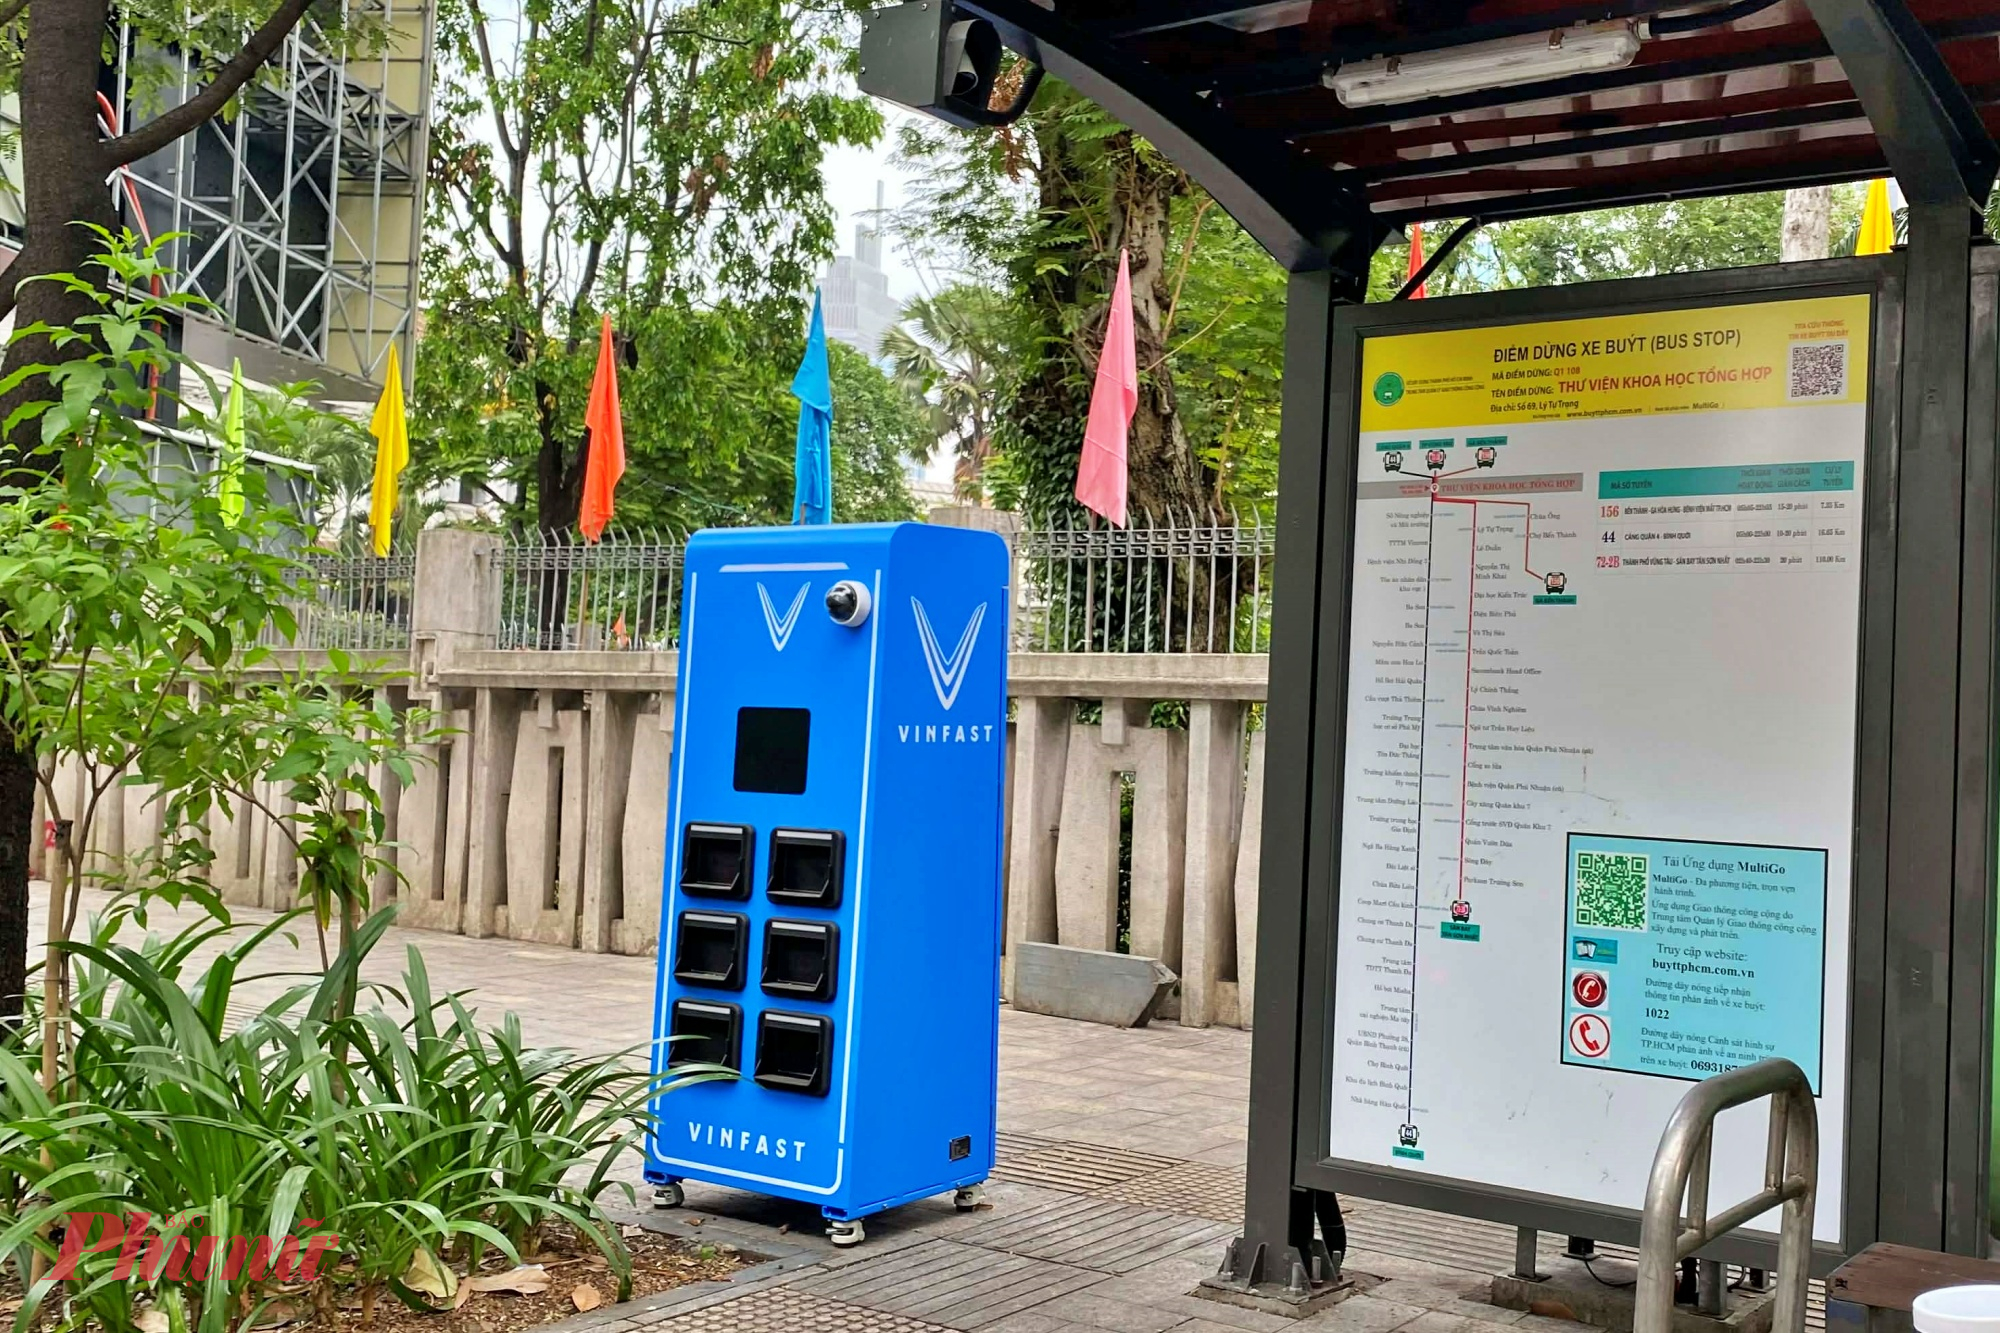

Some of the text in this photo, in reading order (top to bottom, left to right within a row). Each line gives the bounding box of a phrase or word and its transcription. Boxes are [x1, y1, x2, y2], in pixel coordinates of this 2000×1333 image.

[1494, 329, 1741, 363] ĐIỂM DỪNG XE BUÝT (BUS STOP)
[1506, 368, 1526, 379] ĐIỂM
[1527, 368, 1552, 378] DỪNG:
[1554, 368, 1564, 377] Q1
[1567, 366, 1580, 376] 108
[1559, 366, 1772, 394] THƯ VIỆN KHOA HỌC TỔNG HỢP
[1492, 388, 1506, 399] TÊN
[1507, 387, 1527, 397] ĐIỂM
[1528, 386, 1554, 396] DỪNG:
[1491, 404, 1502, 413] Địa
[1517, 402, 1526, 411] Số
[1527, 402, 1538, 411] 69,
[1539, 400, 1548, 411] Lý
[1558, 400, 1579, 410] Trọng
[1692, 402, 1719, 410] MultiGo
[1482, 480, 1508, 491] KHOA
[1601, 506, 1620, 518] 156
[1602, 531, 1616, 543] 44
[1597, 555, 1620, 569] 72-2B
[899, 725, 993, 744] VINFAST
[1682, 855, 1705, 871] Ứng
[1708, 858, 1735, 873] dụng
[1738, 862, 1786, 875] MultiGo
[1652, 874, 1688, 885] MultiGo
[1709, 879, 1740, 891] phương
[1670, 902, 1690, 913] dụng
[1693, 903, 1712, 913] Giao
[1714, 904, 1737, 916] thông
[1739, 907, 1759, 918] công
[1760, 909, 1781, 920] cộng
[1783, 911, 1794, 920] do
[1652, 912, 1675, 923] Trung
[1717, 916, 1725, 928] lý
[1727, 918, 1747, 928] Giao
[1749, 920, 1772, 931] thông
[1773, 923, 1795, 934] công
[1796, 925, 1817, 936] cộng
[1657, 943, 1748, 962] Truy cập website:
[1652, 958, 1755, 978] buyttphcm.com.vn
[1646, 978, 1673, 990] Đường
[1644, 991, 1668, 1001] thông
[1669, 992, 1680, 1001] tin
[1645, 1008, 1670, 1020] 1022
[1641, 1027, 1668, 1039] Đường
[1641, 1040, 1675, 1051] TP.HCM
[1726, 1051, 1736, 1059] an
[1738, 1052, 1757, 1061] ninh
[1657, 1058, 1667, 1066] xe
[688, 1122, 806, 1162] VINFAST
